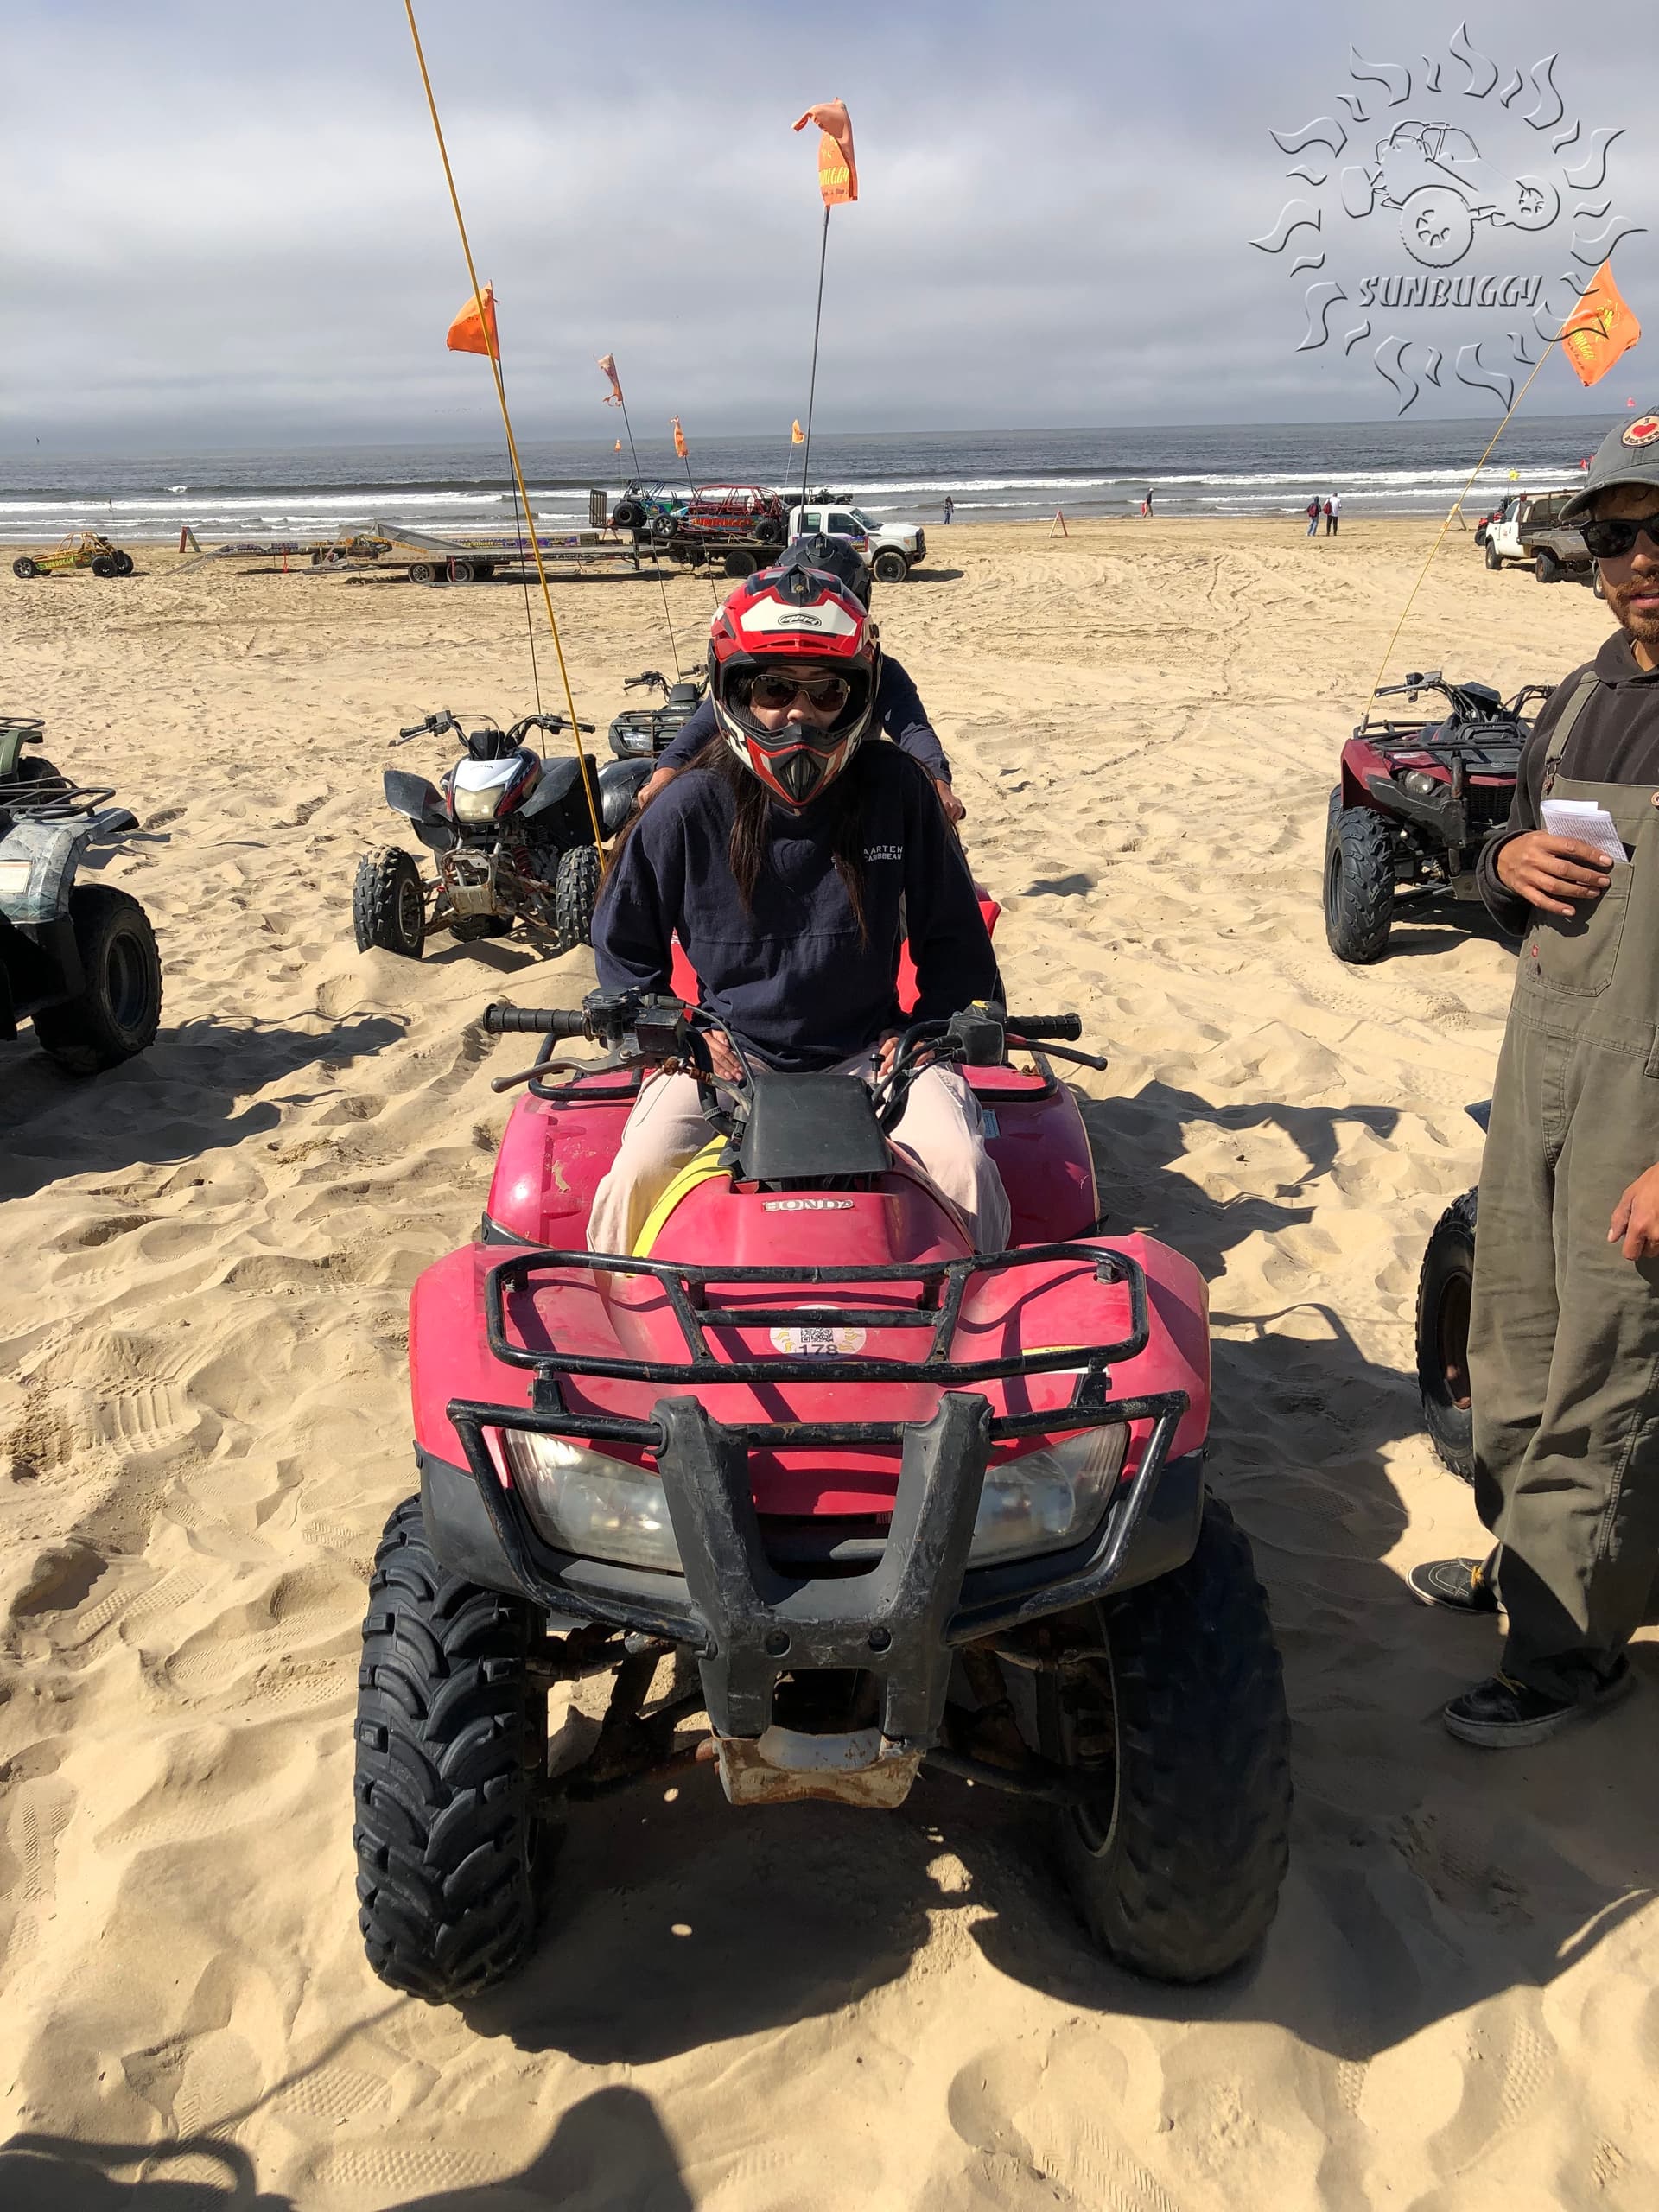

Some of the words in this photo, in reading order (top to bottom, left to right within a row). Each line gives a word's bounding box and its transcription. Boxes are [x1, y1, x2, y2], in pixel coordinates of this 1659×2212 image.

[864, 845, 904, 855] AARTEN
[765, 1198, 855, 1211] HONDA
[798, 1344, 839, 1357] 178
